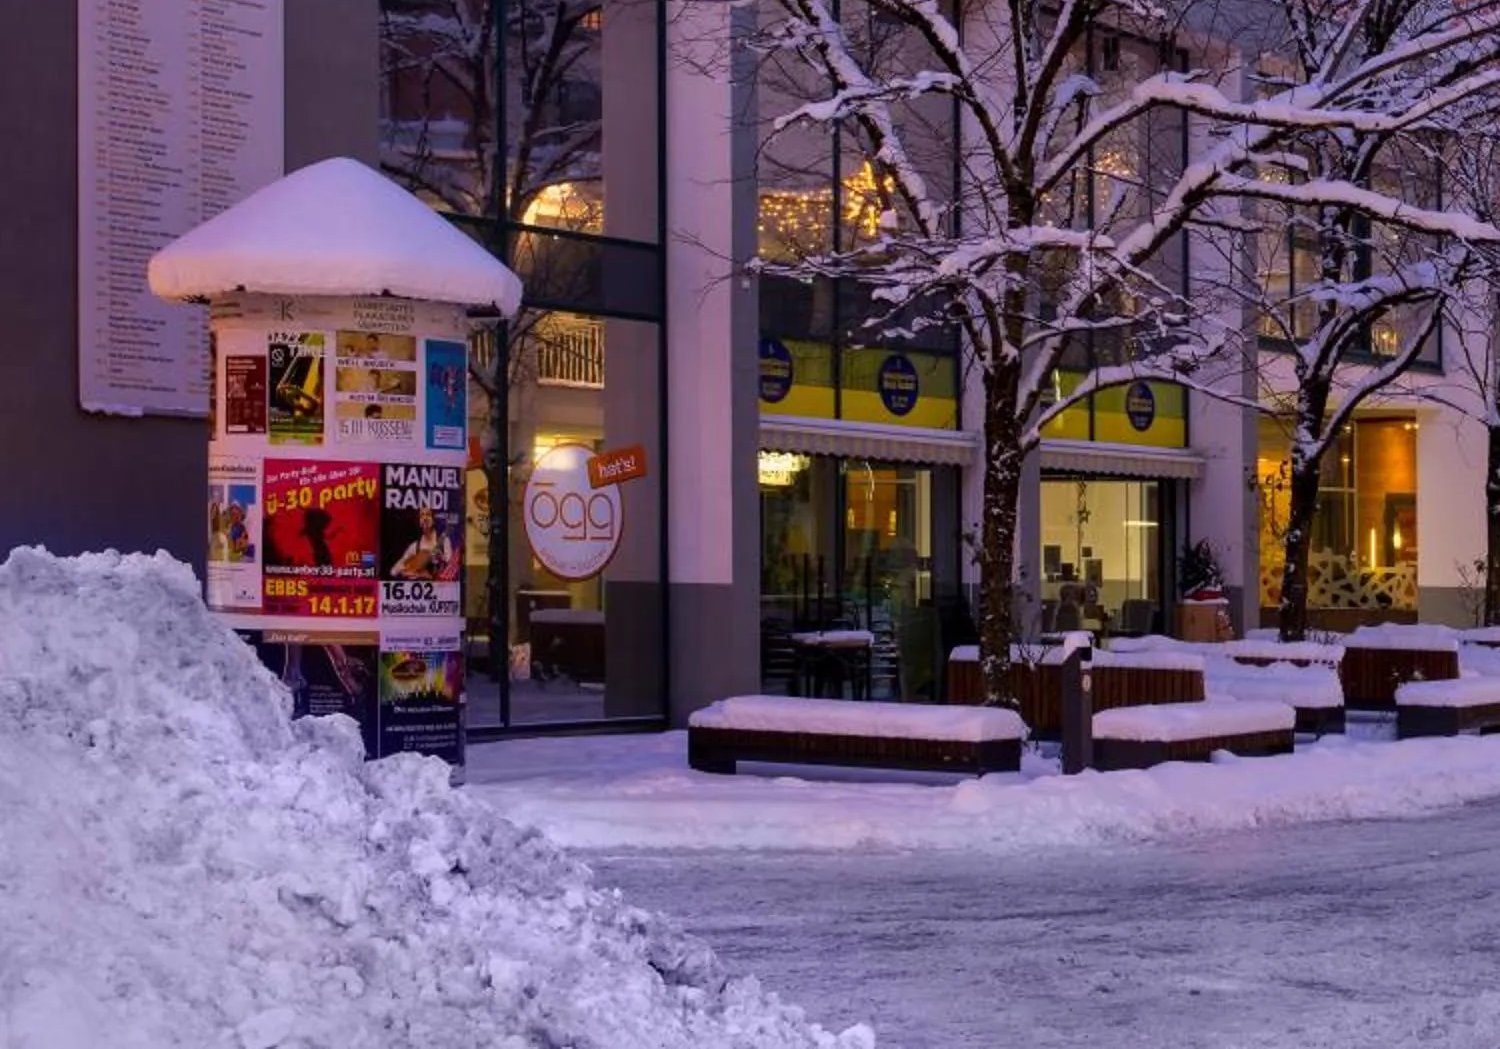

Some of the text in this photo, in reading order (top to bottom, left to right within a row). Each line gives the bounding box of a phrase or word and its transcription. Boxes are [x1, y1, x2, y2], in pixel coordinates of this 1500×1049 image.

[385, 464, 459, 489] MANUEL
[319, 477, 377, 510] party
[385, 488, 449, 511] RANDI
[265, 578, 309, 597] EBBS
[383, 582, 437, 601] 16.02.
[308, 596, 376, 615] 14.1.17
